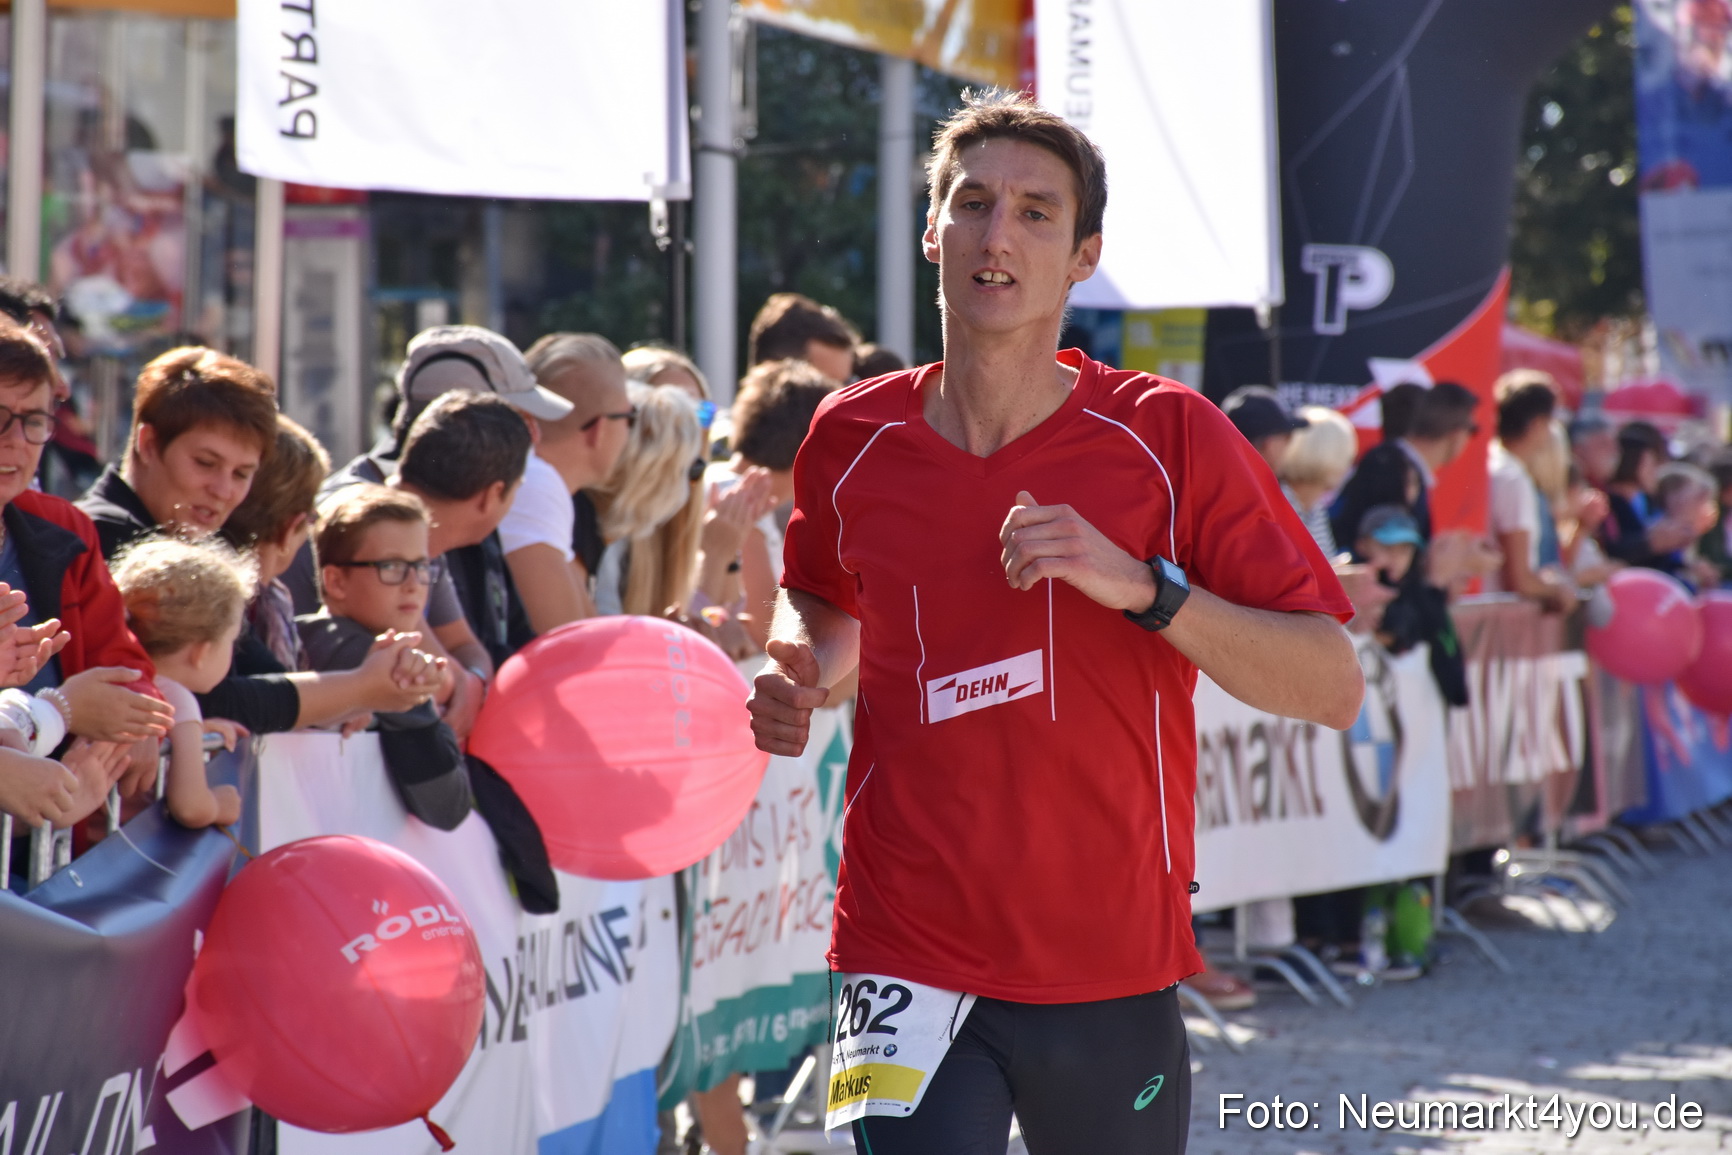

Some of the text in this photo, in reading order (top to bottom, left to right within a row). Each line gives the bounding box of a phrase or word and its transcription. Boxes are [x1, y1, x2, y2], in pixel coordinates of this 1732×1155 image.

[956, 672, 1009, 703] DEHN
[340, 899, 461, 965] RÖDL
[422, 923, 466, 941] energie
[836, 979, 912, 1042] 262
[847, 1045, 880, 1060] Neumarkt
[830, 1074, 872, 1106] Markus
